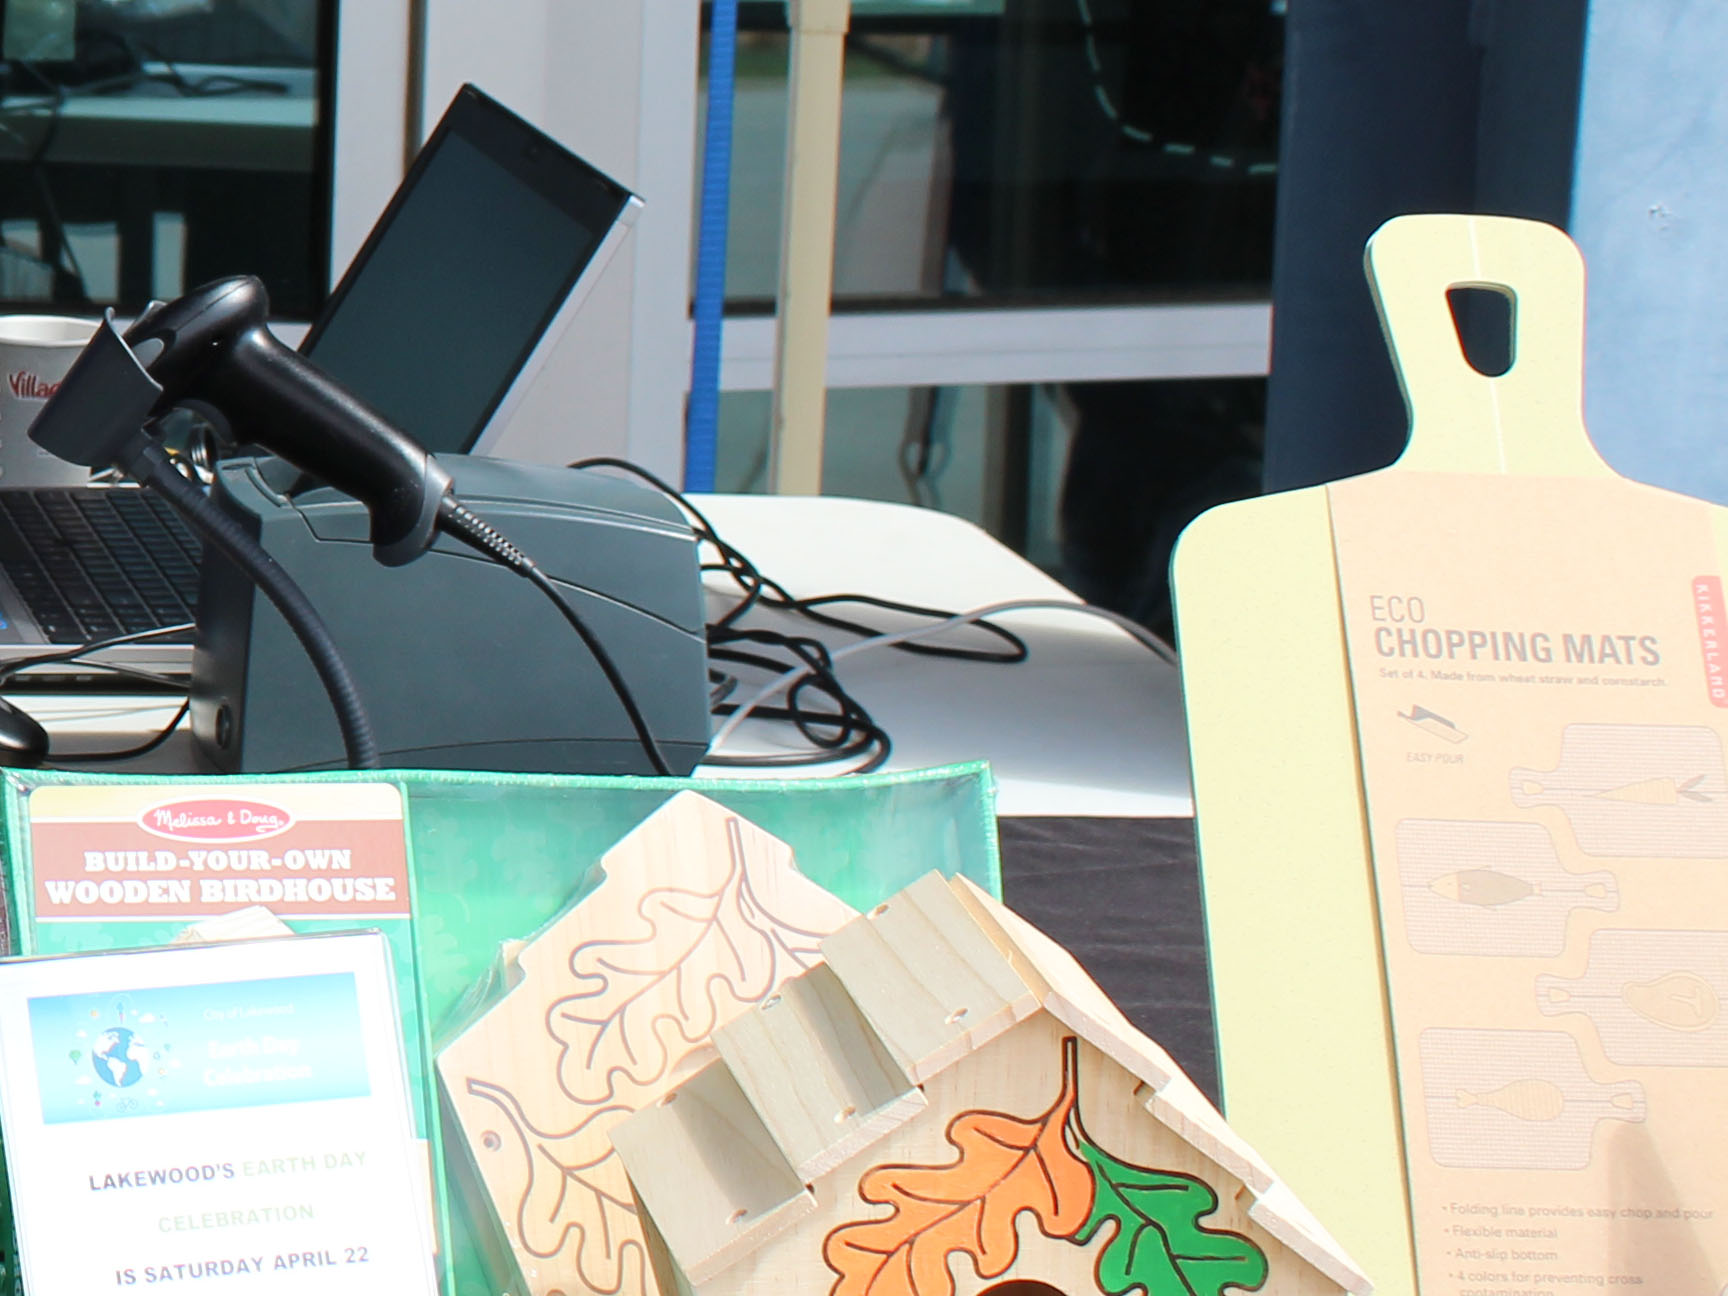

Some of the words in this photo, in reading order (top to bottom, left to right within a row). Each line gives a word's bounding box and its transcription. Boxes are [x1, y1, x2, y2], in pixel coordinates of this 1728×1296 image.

[1370, 595, 1425, 623] ECO
[1375, 627, 1553, 663] CHOPPING
[1562, 634, 1660, 665] MATS
[1696, 584, 1726, 700] KIKKERLAND
[1380, 668, 1398, 679] Set
[1402, 669, 1414, 679] of
[1431, 671, 1464, 681] Made
[1466, 672, 1495, 682] from
[1499, 673, 1536, 683] wheat
[1539, 675, 1573, 684] straw
[1578, 675, 1598, 685] and
[154, 807, 222, 831] Melissa
[84, 848, 352, 872] BUILD-YOUR-OWN
[45, 879, 192, 905] WOODEN
[200, 876, 396, 904] BIRDHOUSE
[243, 1155, 316, 1177] EARTH
[324, 1151, 367, 1170] DAY
[158, 1204, 314, 1232] CELEBRATION
[1450, 1203, 1498, 1217] Folding
[116, 1268, 136, 1285] IS
[144, 1255, 264, 1282] SATURDAY
[273, 1250, 336, 1271] APRIL
[345, 1246, 369, 1263] 22
